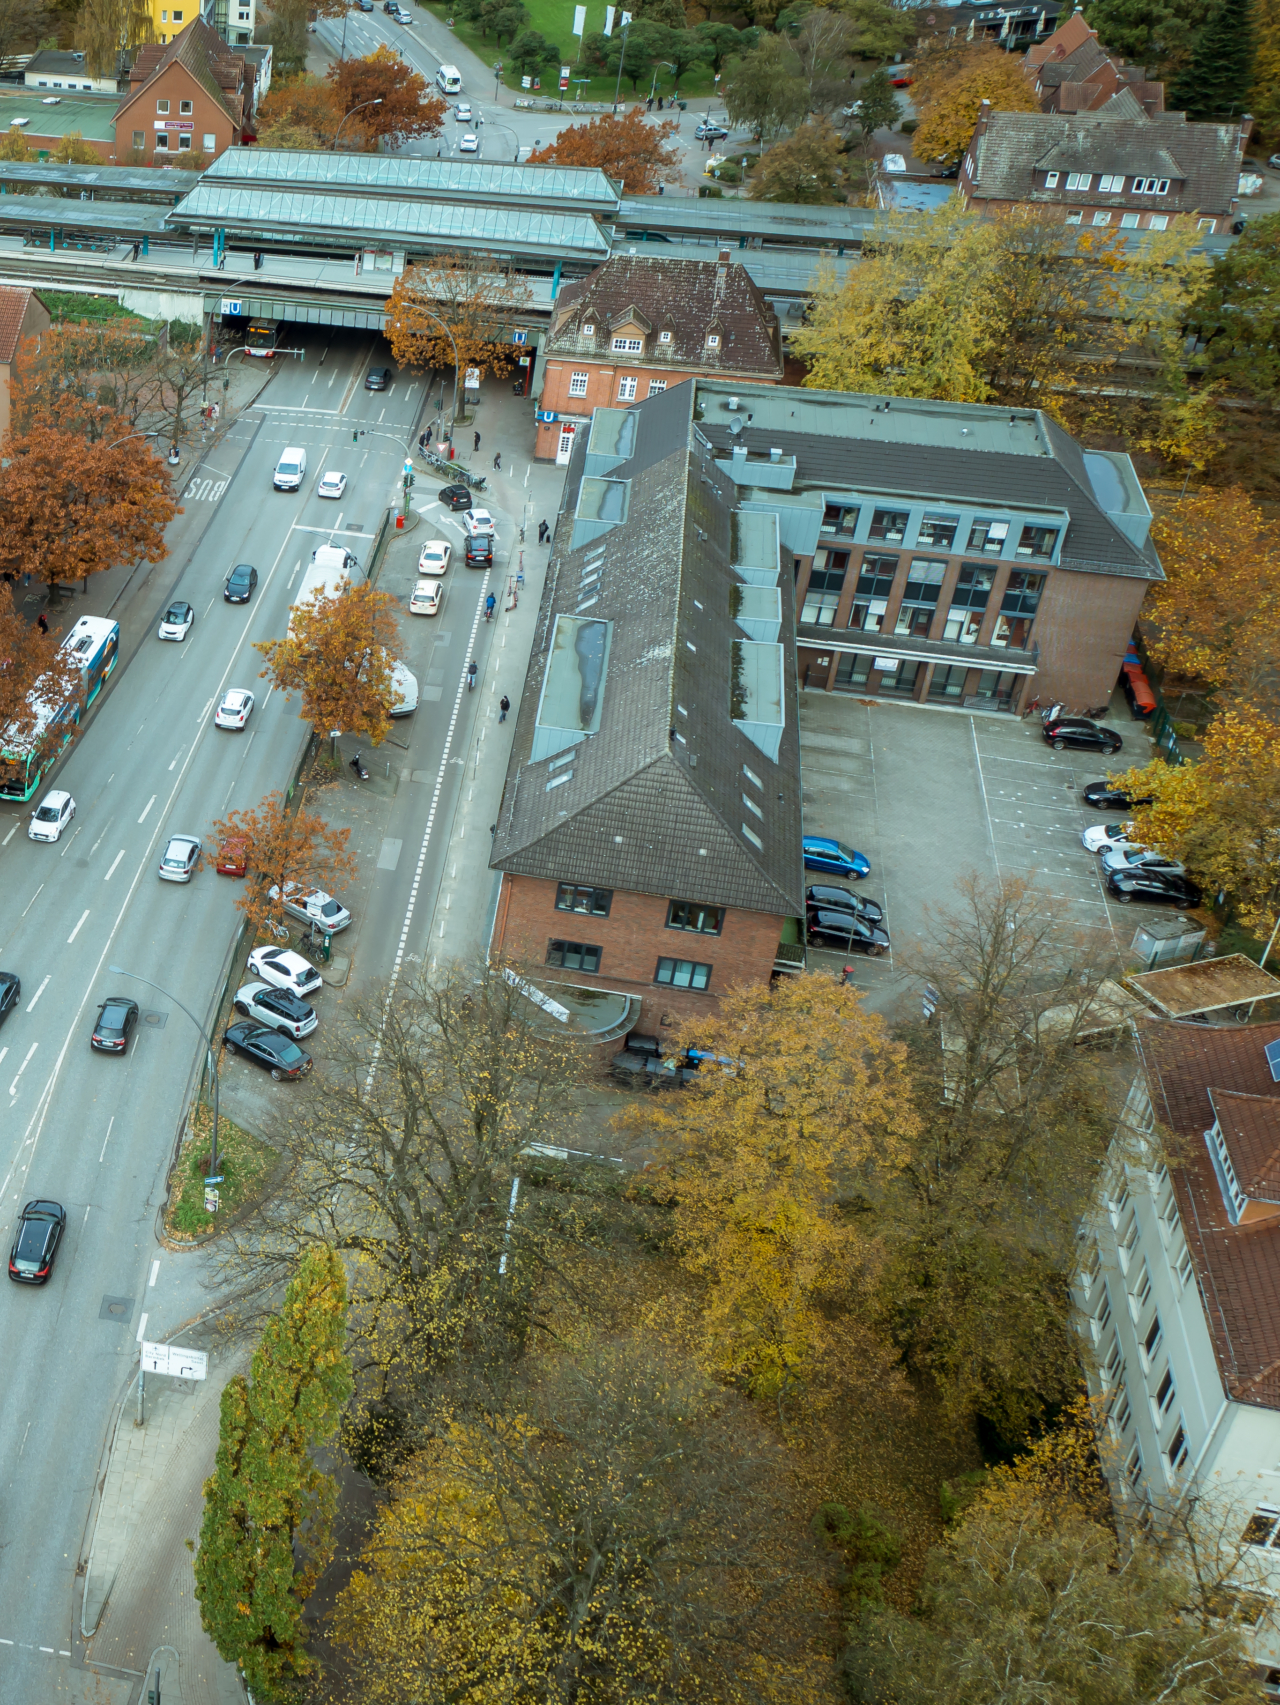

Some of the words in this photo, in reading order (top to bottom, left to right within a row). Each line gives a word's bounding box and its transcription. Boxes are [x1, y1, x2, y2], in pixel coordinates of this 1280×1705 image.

[231, 303, 240, 314] U
[544, 411, 554, 422] U
[184, 477, 226, 501] BUS
